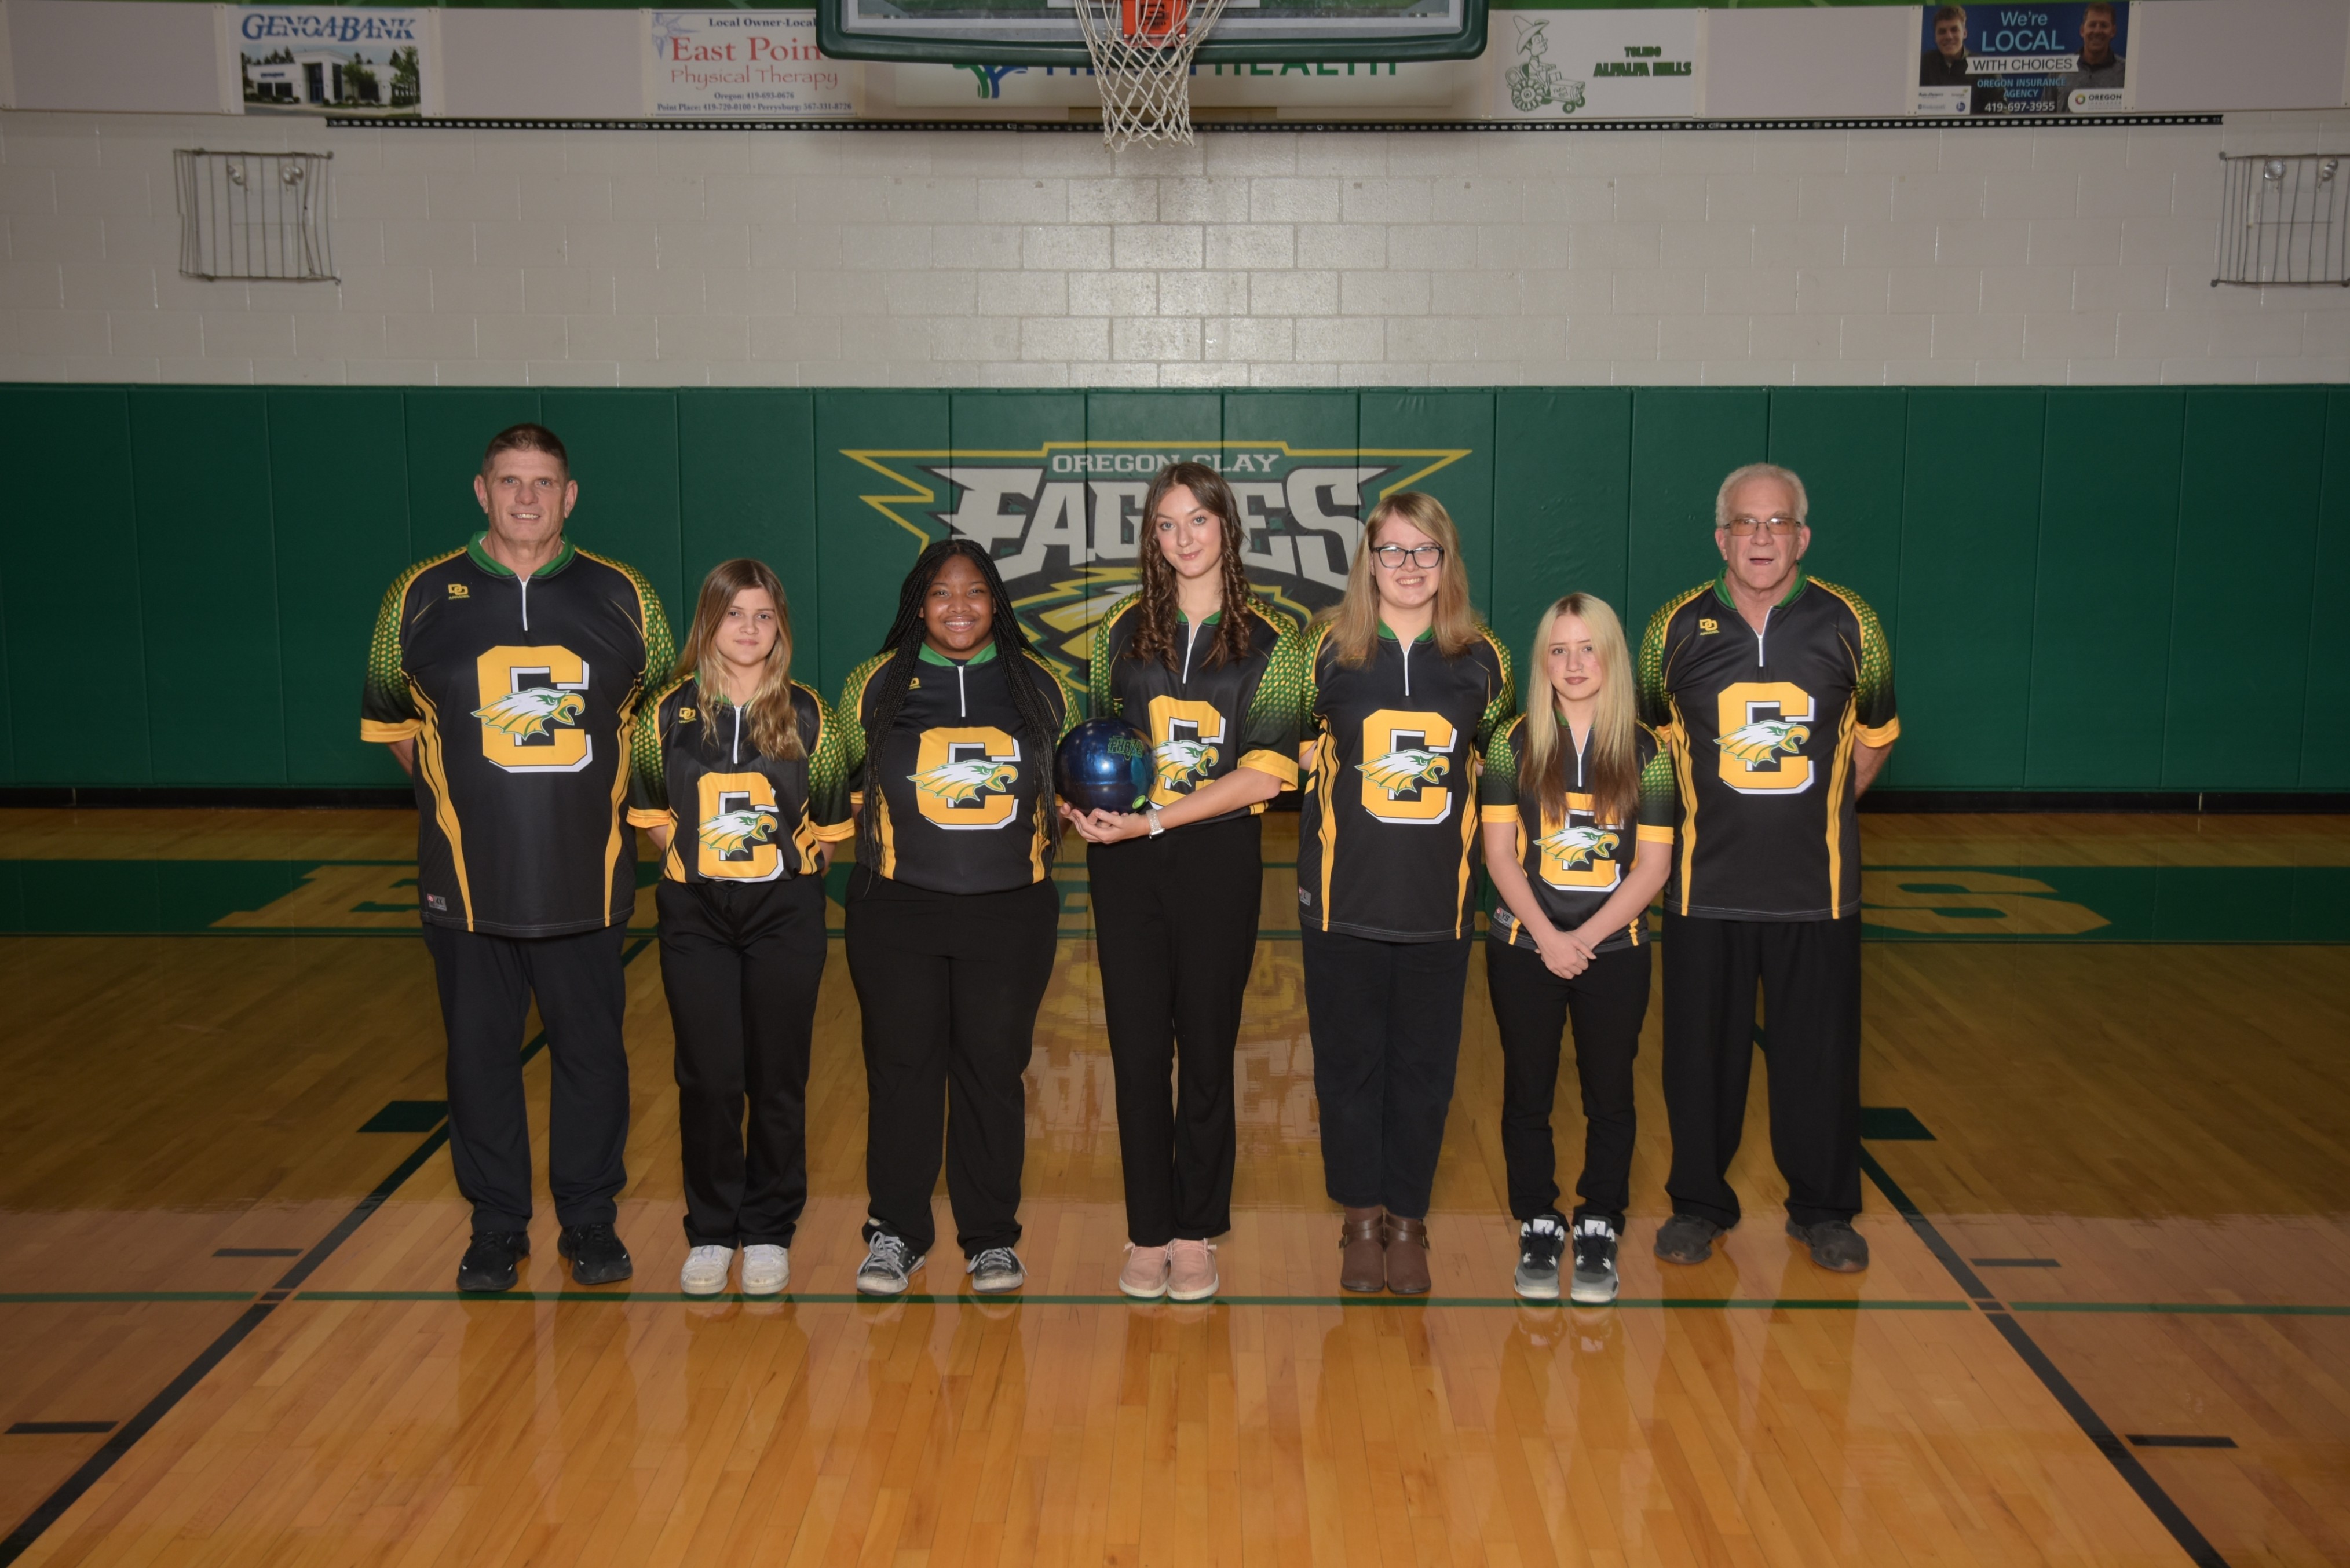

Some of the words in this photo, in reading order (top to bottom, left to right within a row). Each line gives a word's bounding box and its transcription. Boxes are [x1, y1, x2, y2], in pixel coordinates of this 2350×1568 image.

[708, 18, 740, 27] Local
[2001, 11, 2048, 26] We're
[1982, 30, 2065, 52] LOCAL
[670, 36, 736, 61] East
[747, 36, 823, 62] Poin
[1624, 46, 1662, 57] TOLEDO
[1593, 62, 1650, 77] ALFALFA
[1653, 61, 1692, 76] MILLS
[1973, 60, 2007, 71] WITH
[2011, 59, 2073, 71] CHOICES
[671, 65, 750, 90] Physical
[755, 65, 838, 90] Therapy
[1977, 79, 2015, 88] OREGON
[2016, 78, 2066, 87] INSURANCE
[714, 92, 744, 101] Oregon:
[2004, 89, 2038, 98] AGENCY
[657, 104, 677, 112] Point
[679, 103, 701, 111] Place:
[758, 103, 802, 113] Perrysburg:
[1985, 101, 2055, 112] 419-697-3955
[1052, 454, 1180, 473] OREGON
[930, 468, 1389, 591] EAGES
